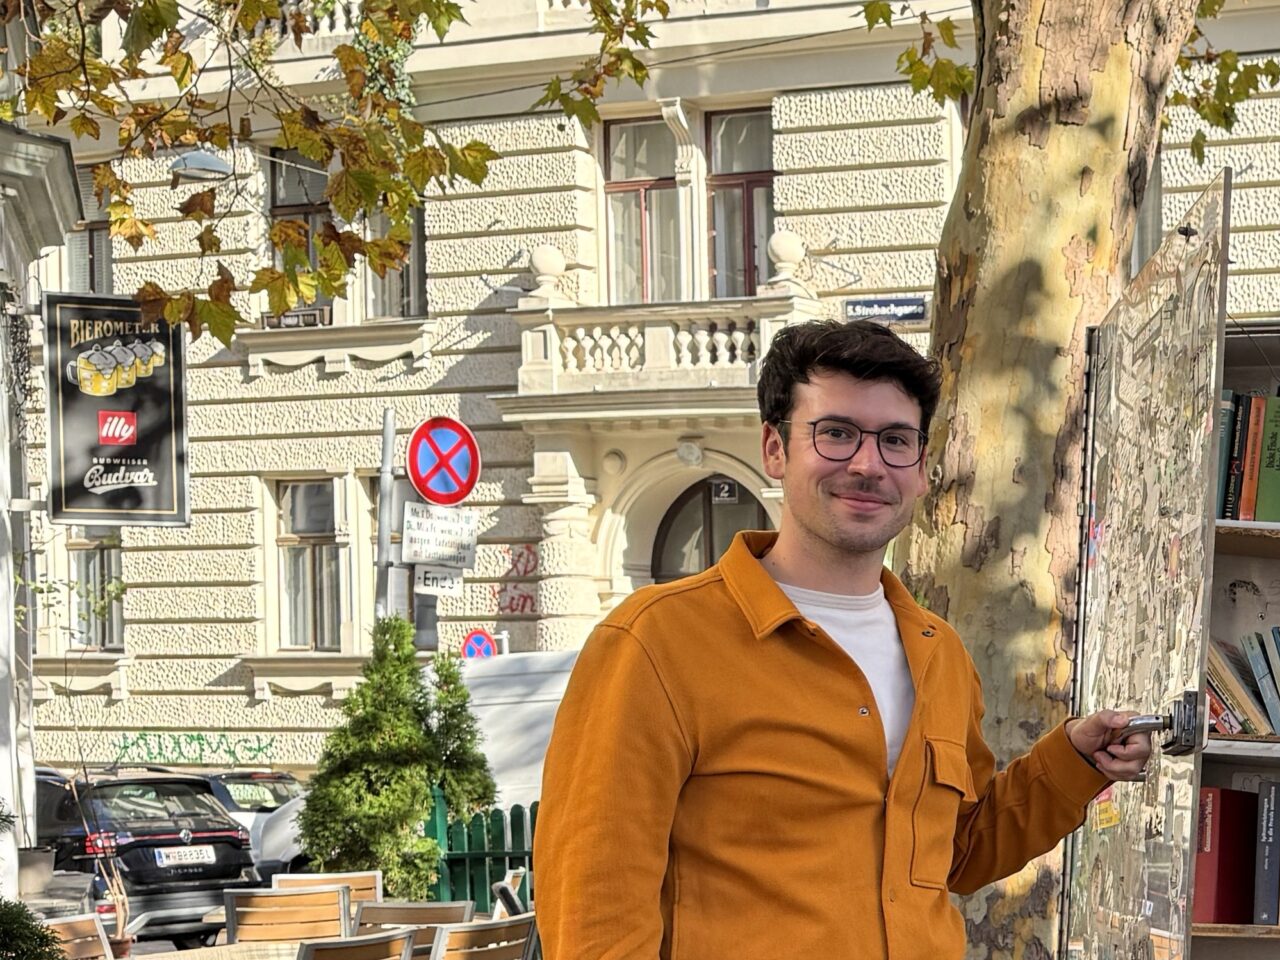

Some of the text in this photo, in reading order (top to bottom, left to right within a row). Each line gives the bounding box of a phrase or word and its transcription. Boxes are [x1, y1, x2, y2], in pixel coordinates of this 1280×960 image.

[70, 318, 160, 349] BIEROMETR
[101, 415, 135, 443] illy
[92, 457, 148, 465] BUDWEISER
[83, 464, 158, 493] Budvar
[719, 483, 730, 498] 2
